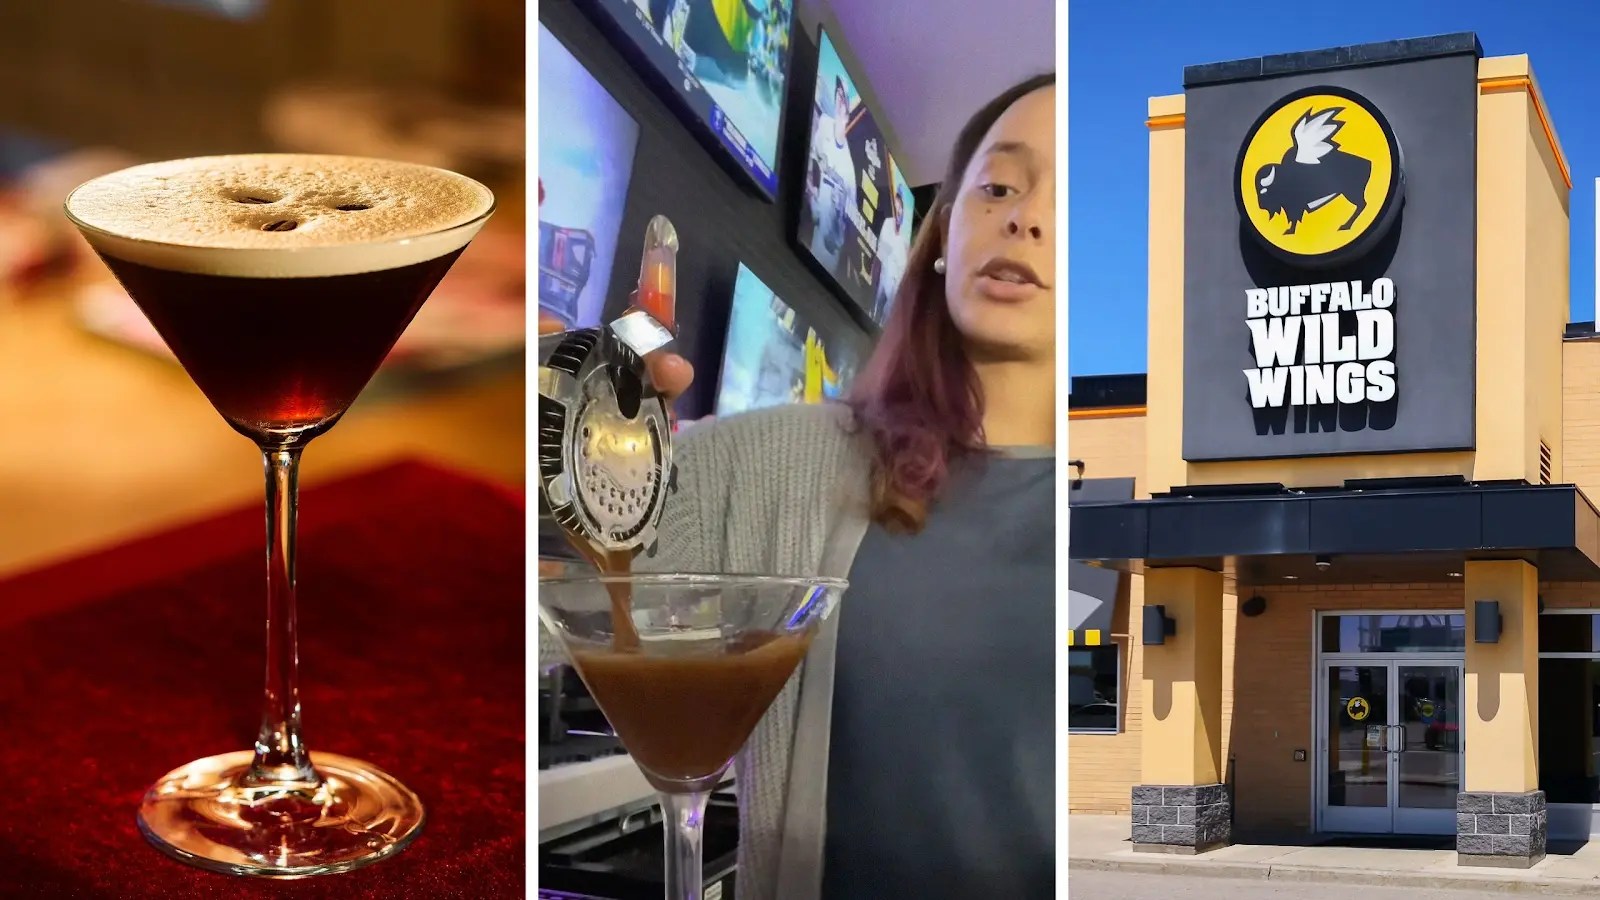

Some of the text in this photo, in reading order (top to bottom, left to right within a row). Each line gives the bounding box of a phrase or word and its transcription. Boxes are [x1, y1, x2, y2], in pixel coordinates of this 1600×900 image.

[1245, 277, 1394, 318] BUFFALO
[1245, 309, 1394, 368] WILD
[1243, 360, 1396, 408] WINGS
